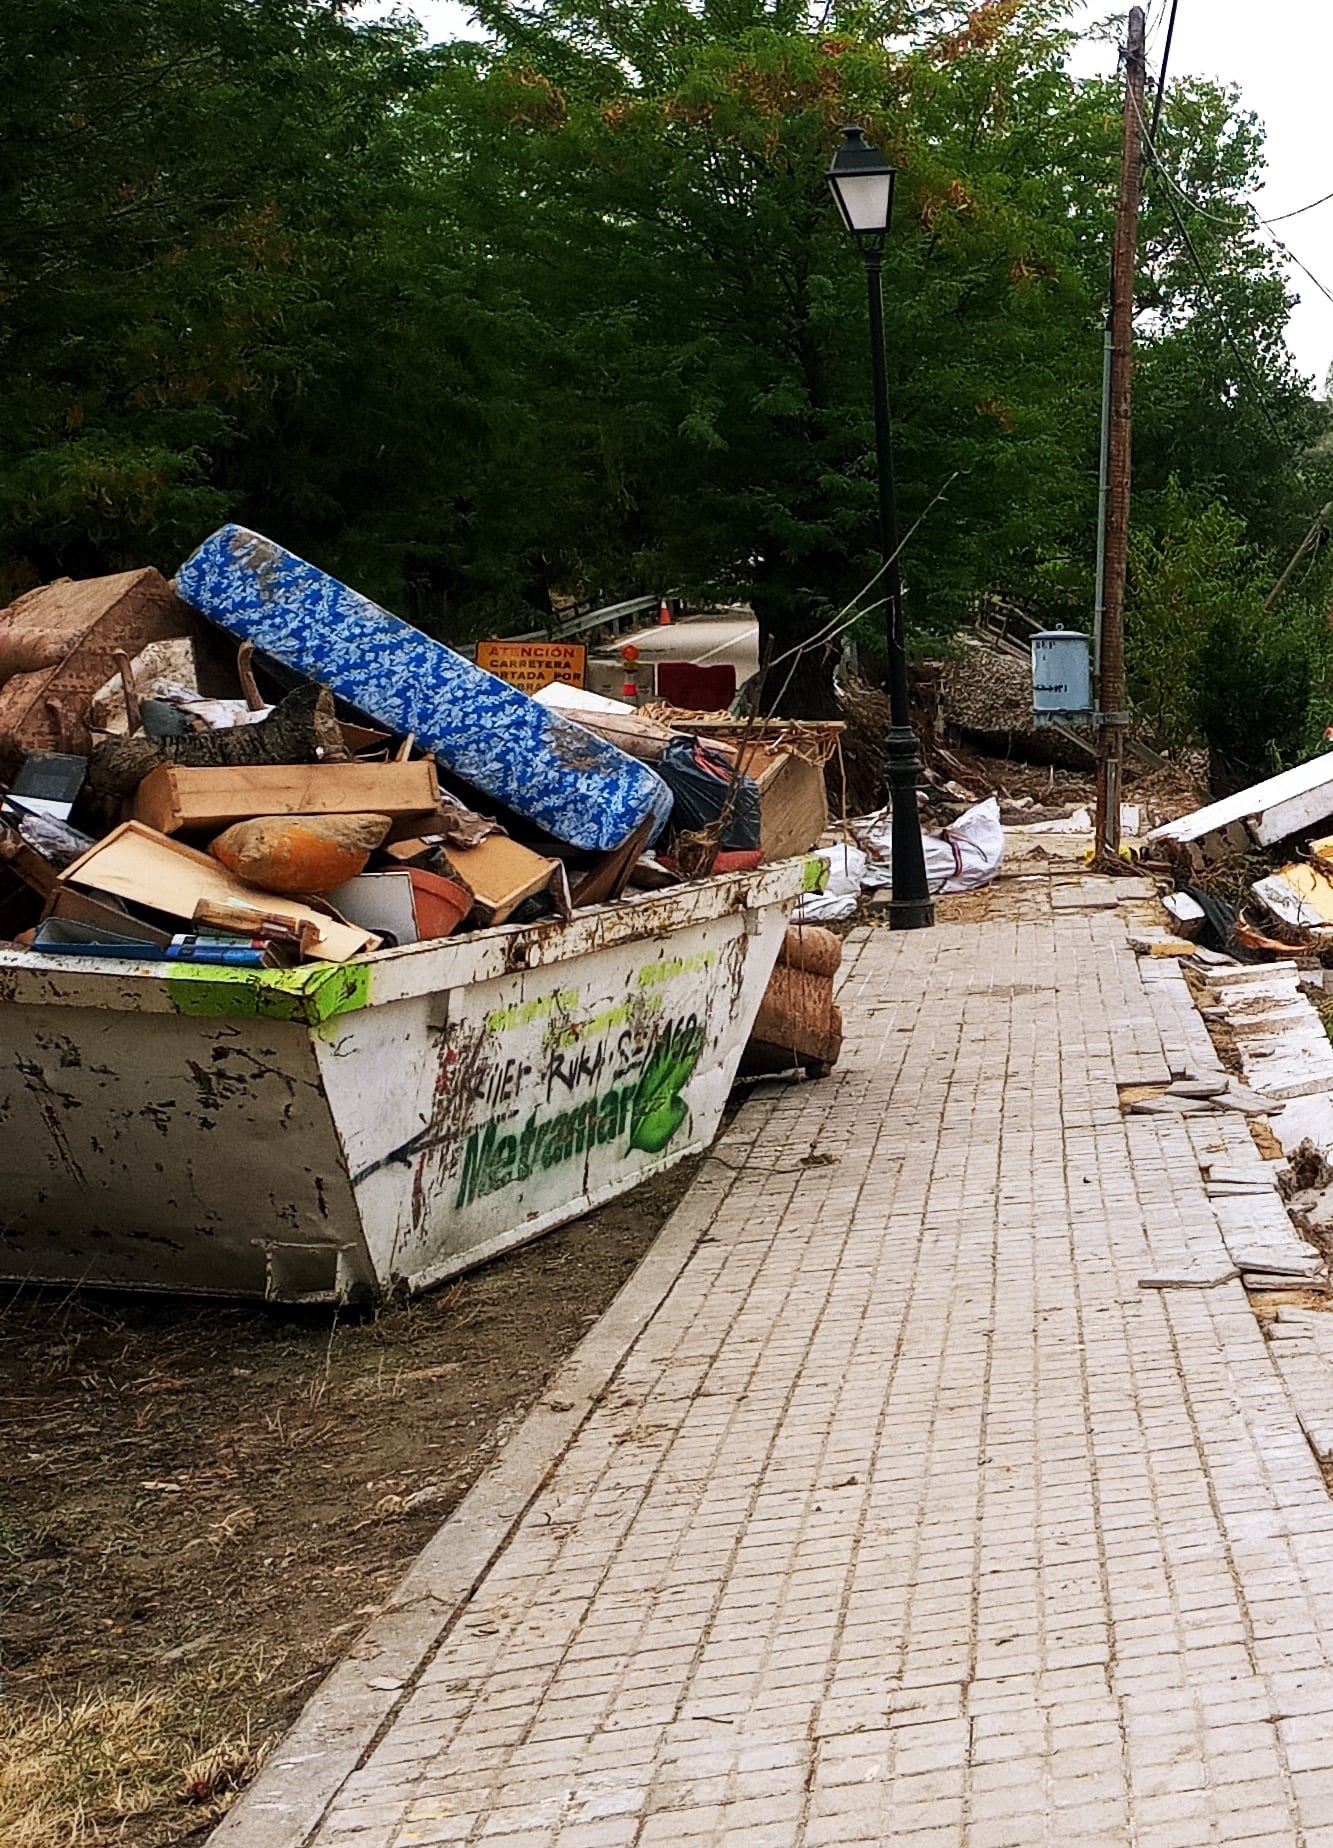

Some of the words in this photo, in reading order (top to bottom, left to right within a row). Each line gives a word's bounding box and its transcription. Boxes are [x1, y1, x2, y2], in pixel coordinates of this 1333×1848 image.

[488, 646, 575, 658] ATENCIÓN
[490, 659, 572, 669] CARRETERA
[491, 671, 546, 681] ORTADA
[553, 672, 582, 681] POR
